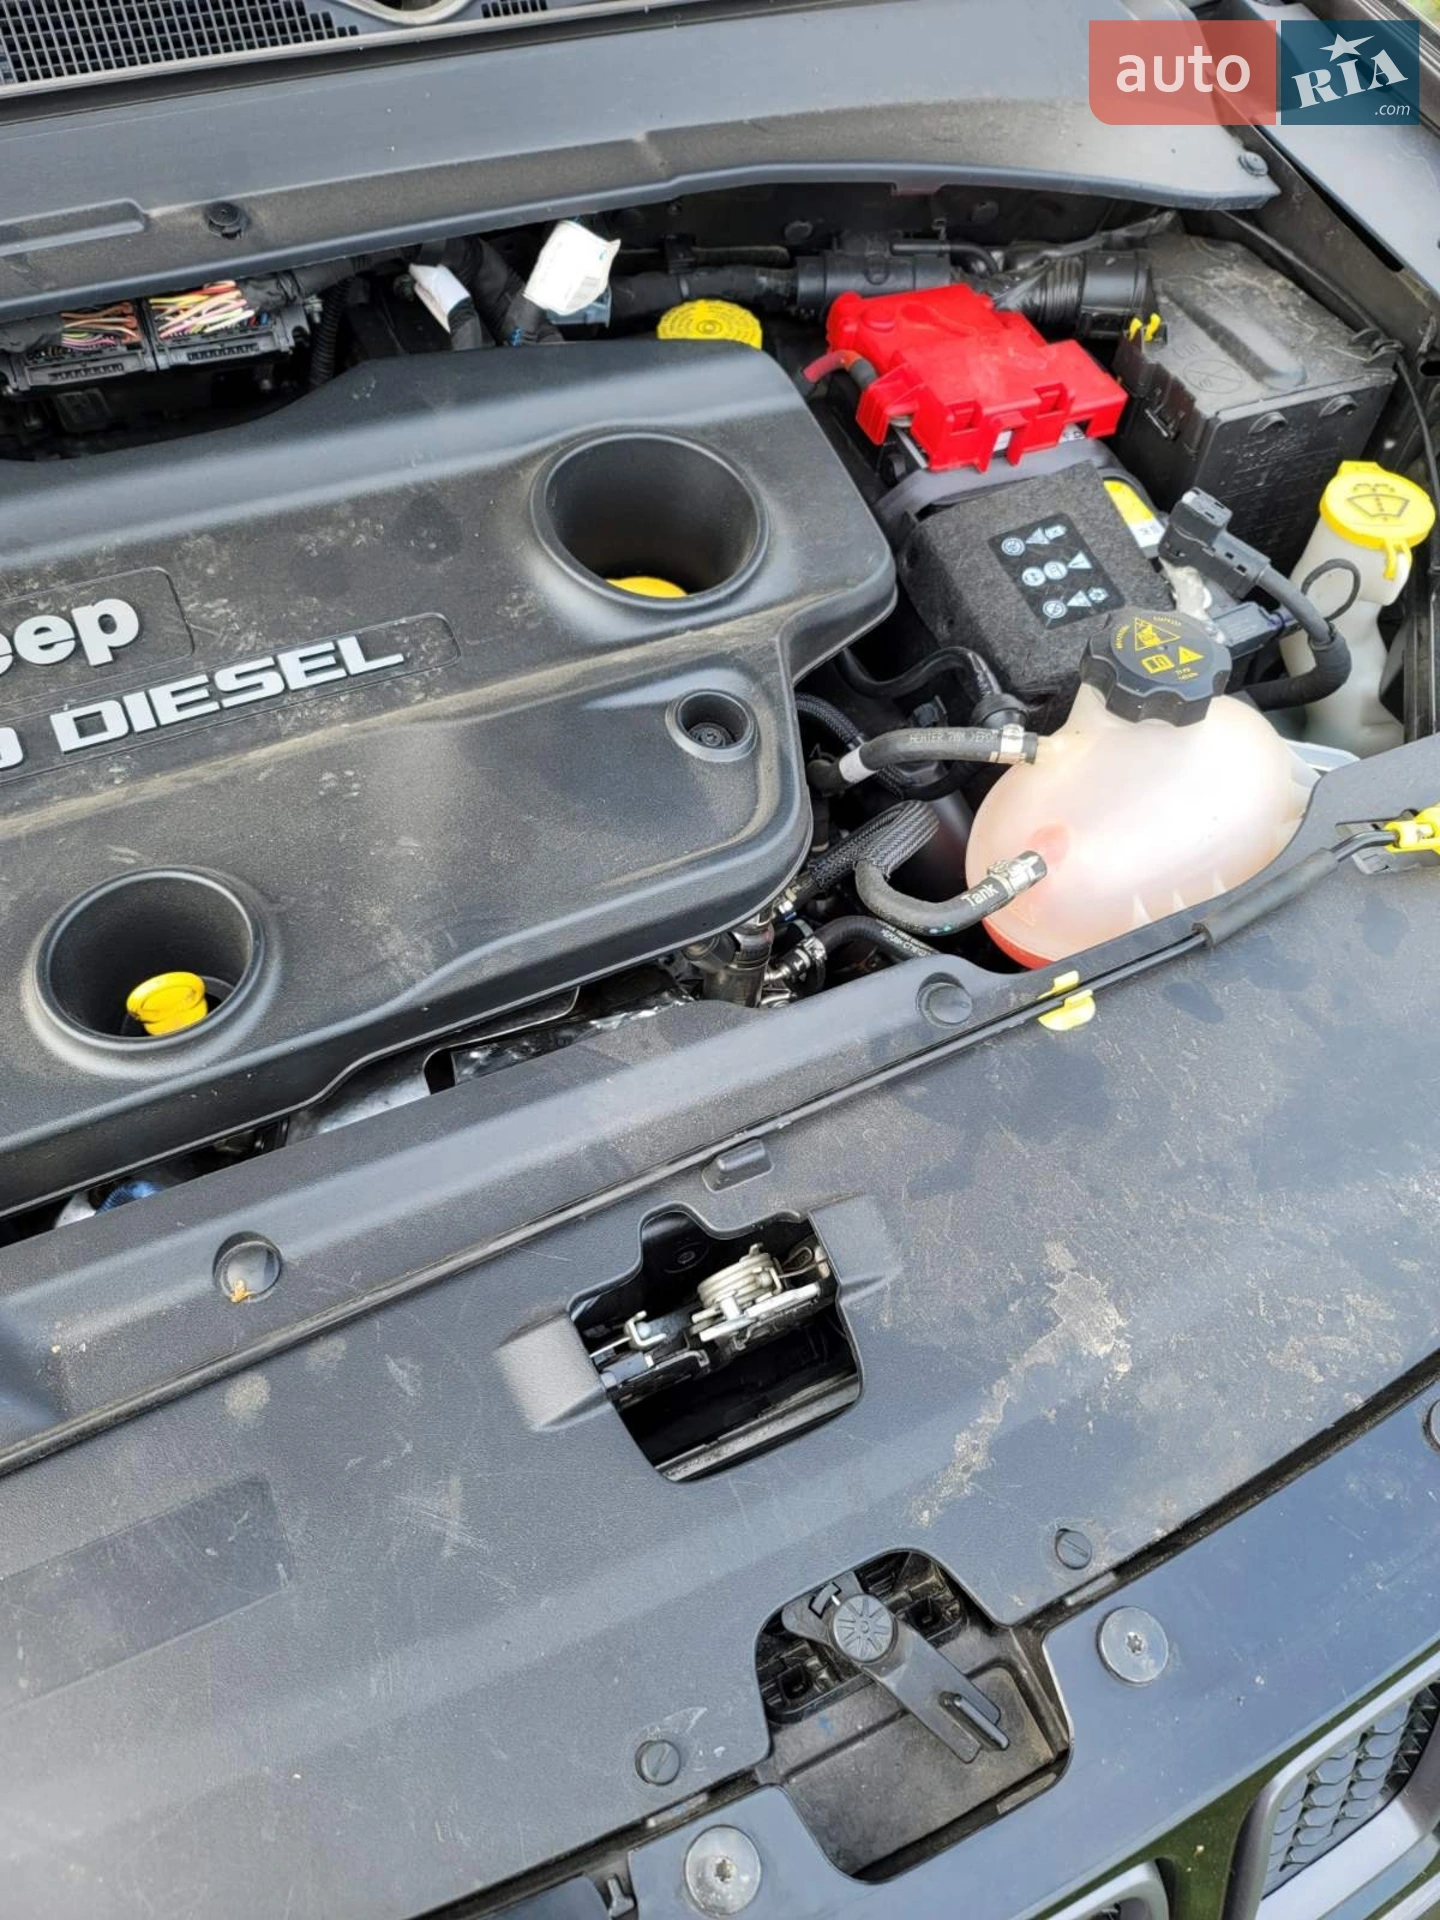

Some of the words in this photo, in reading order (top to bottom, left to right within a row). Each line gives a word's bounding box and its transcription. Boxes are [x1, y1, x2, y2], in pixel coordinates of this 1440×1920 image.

[0, 598, 139, 677] ep
[50, 636, 404, 752] DIESEL
[960, 882, 999, 907] Tank
